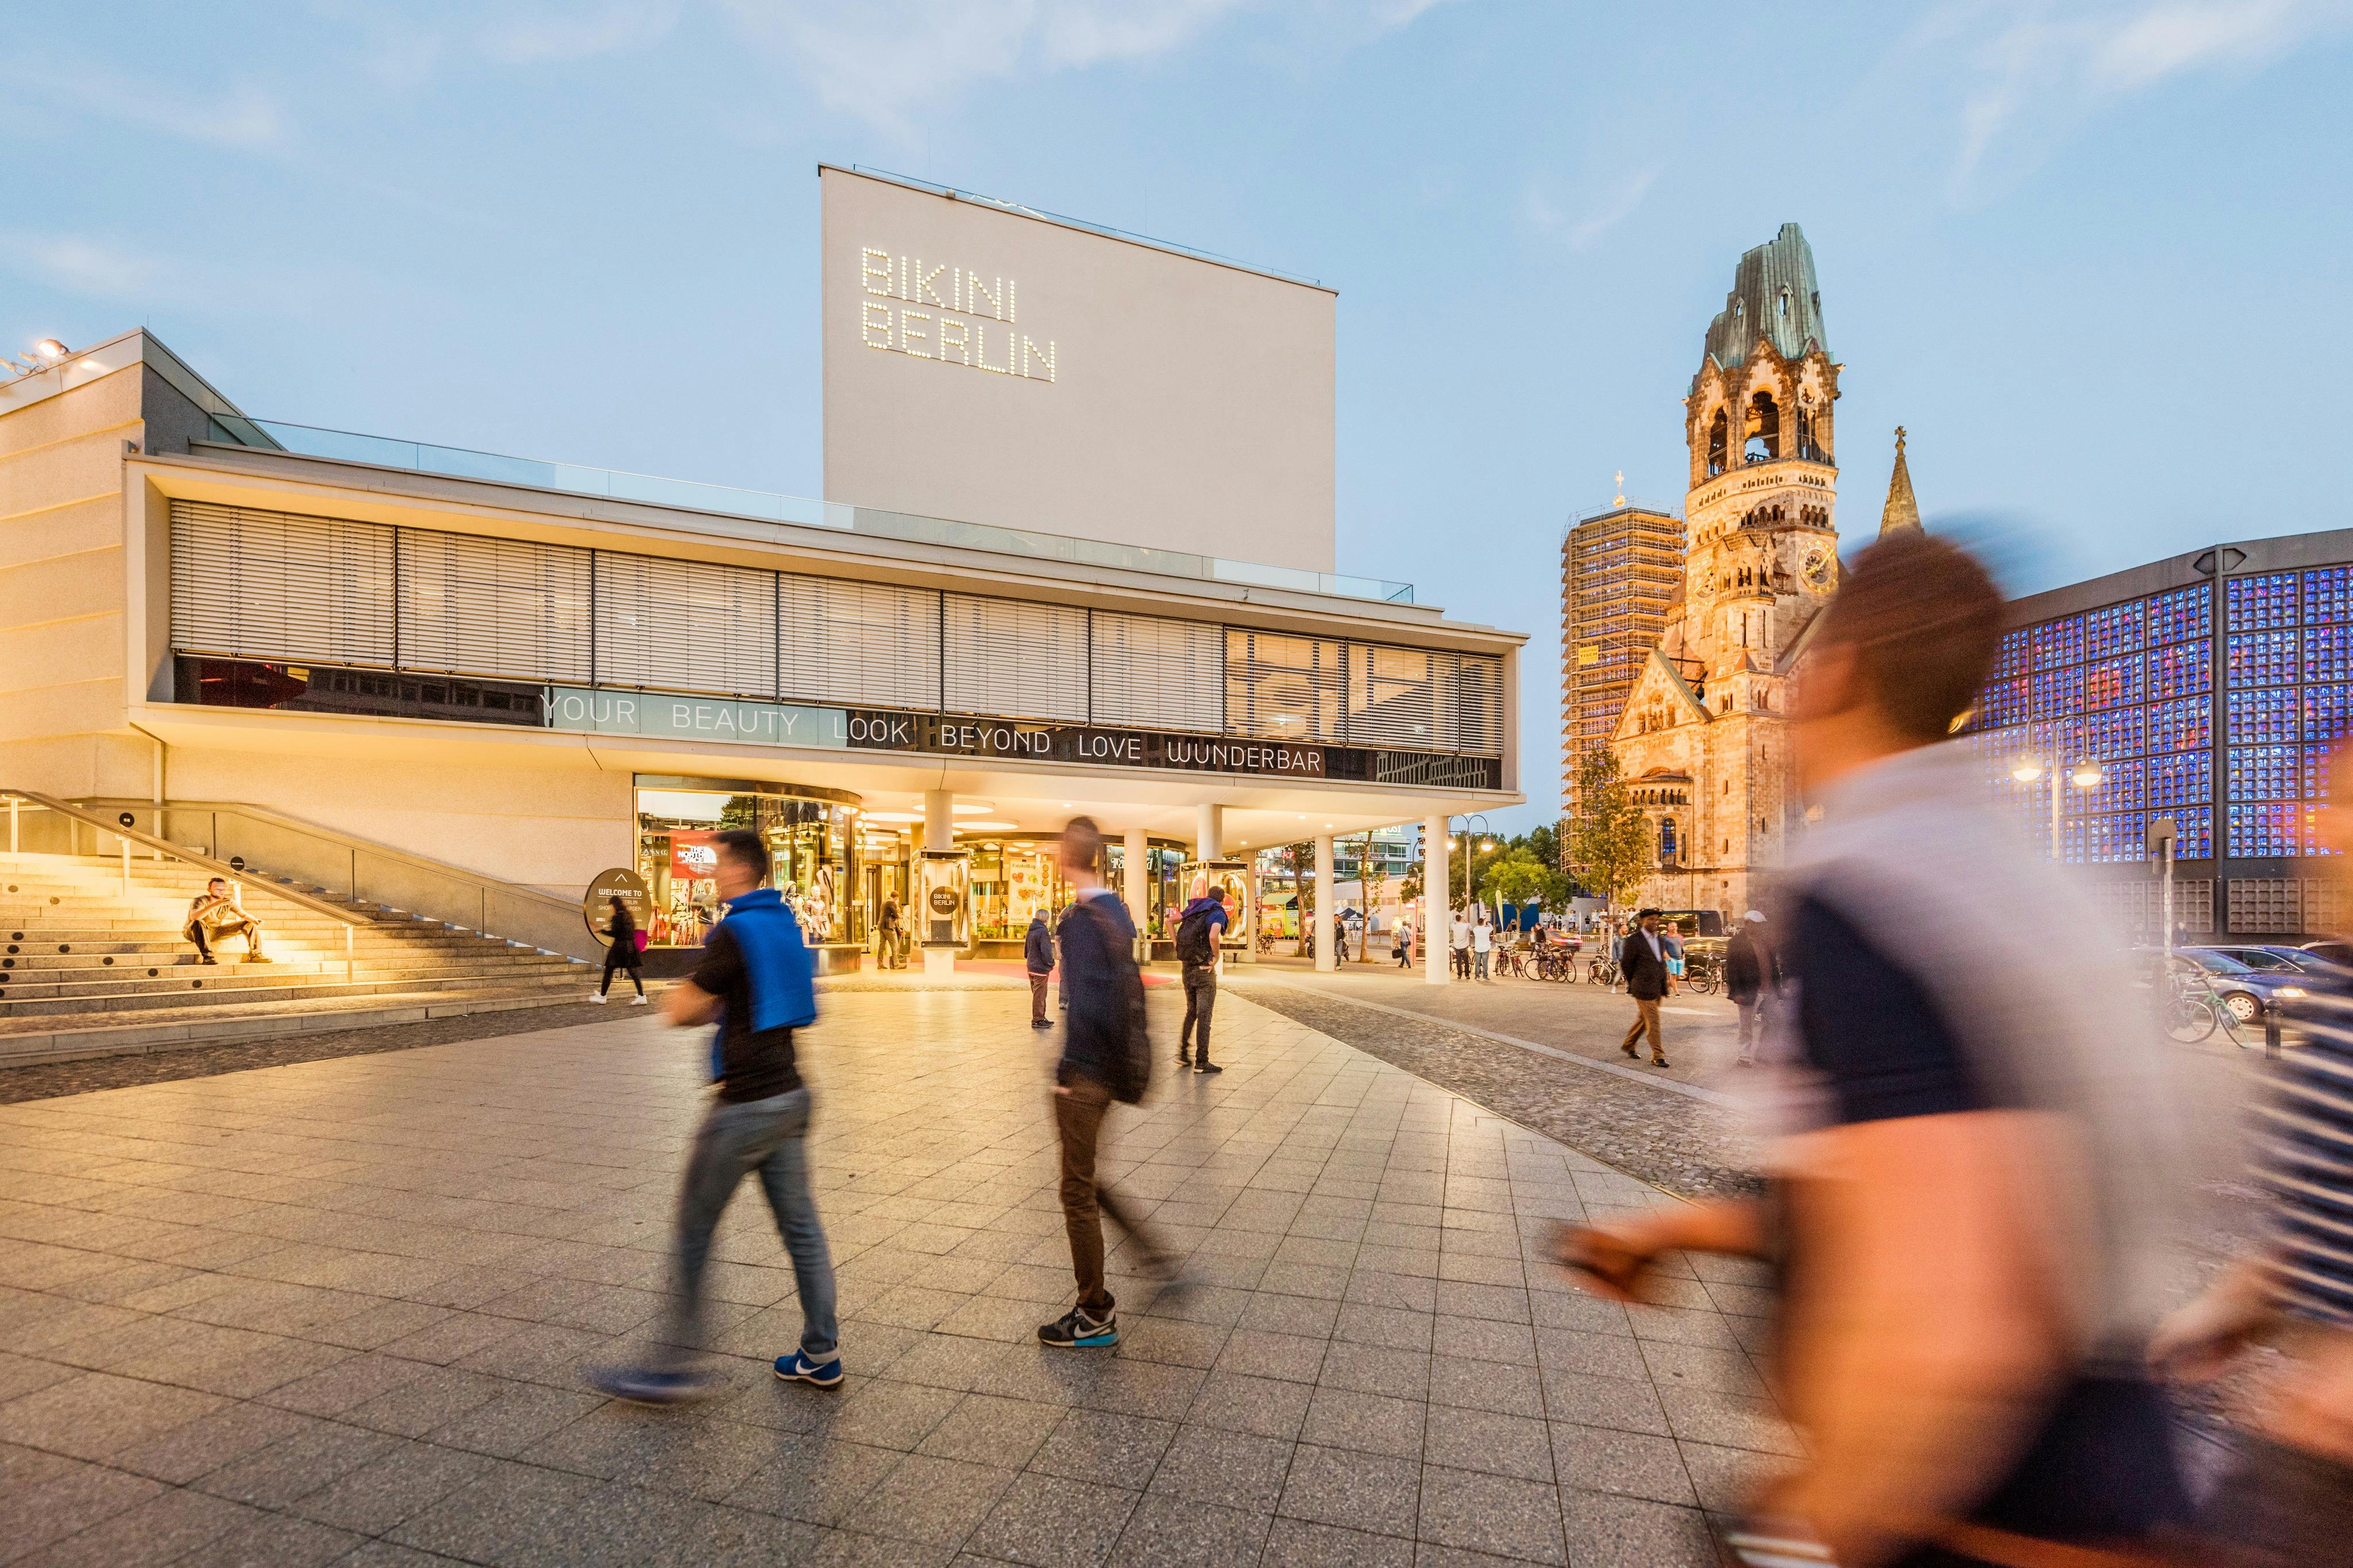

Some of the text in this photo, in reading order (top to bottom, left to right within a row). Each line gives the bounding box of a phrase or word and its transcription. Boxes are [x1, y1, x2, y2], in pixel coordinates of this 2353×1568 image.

[862, 247, 1015, 323] BIKINI
[862, 301, 1055, 383] BERLIN
[539, 694, 1321, 771] YOUR BEAUTY LOOK BEYOND LOVE WUNDERBAR
[598, 889, 632, 897] WELCOME
